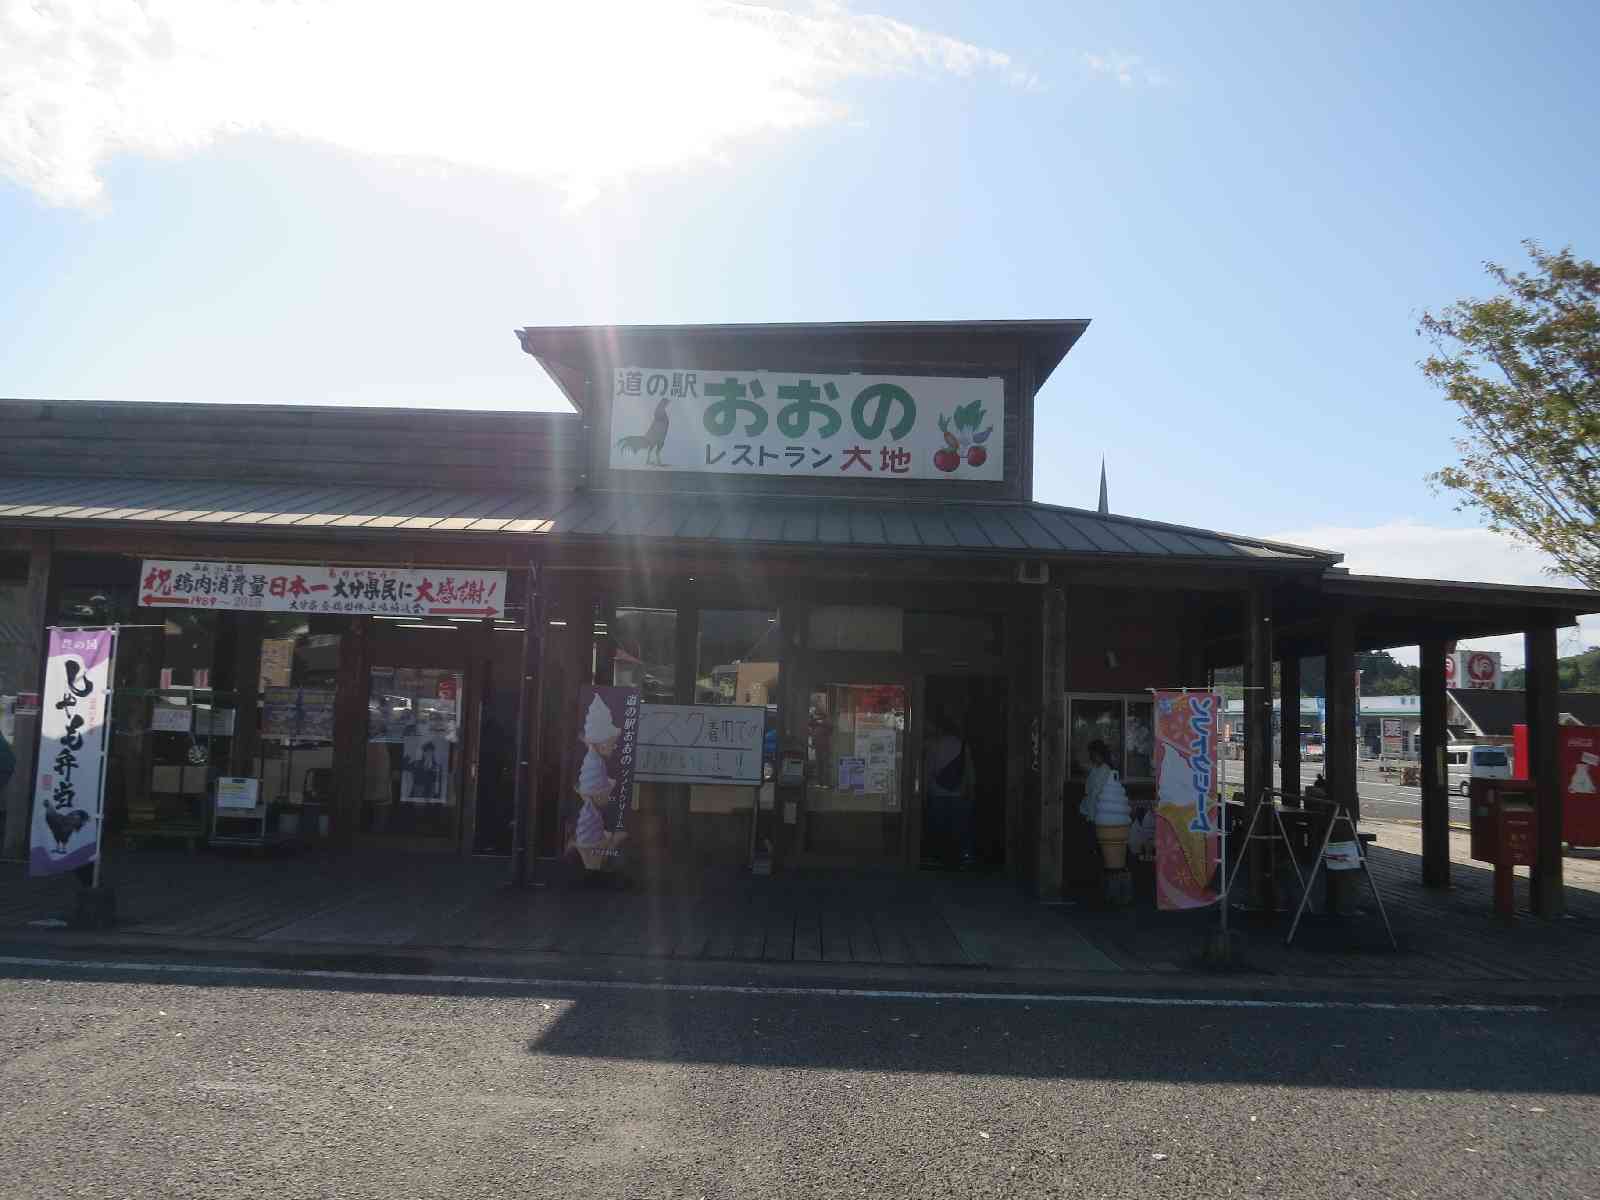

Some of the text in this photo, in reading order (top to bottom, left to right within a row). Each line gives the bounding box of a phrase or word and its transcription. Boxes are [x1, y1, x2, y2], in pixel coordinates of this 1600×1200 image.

[618, 372, 698, 398] 道の駅
[702, 377, 917, 441] おおの
